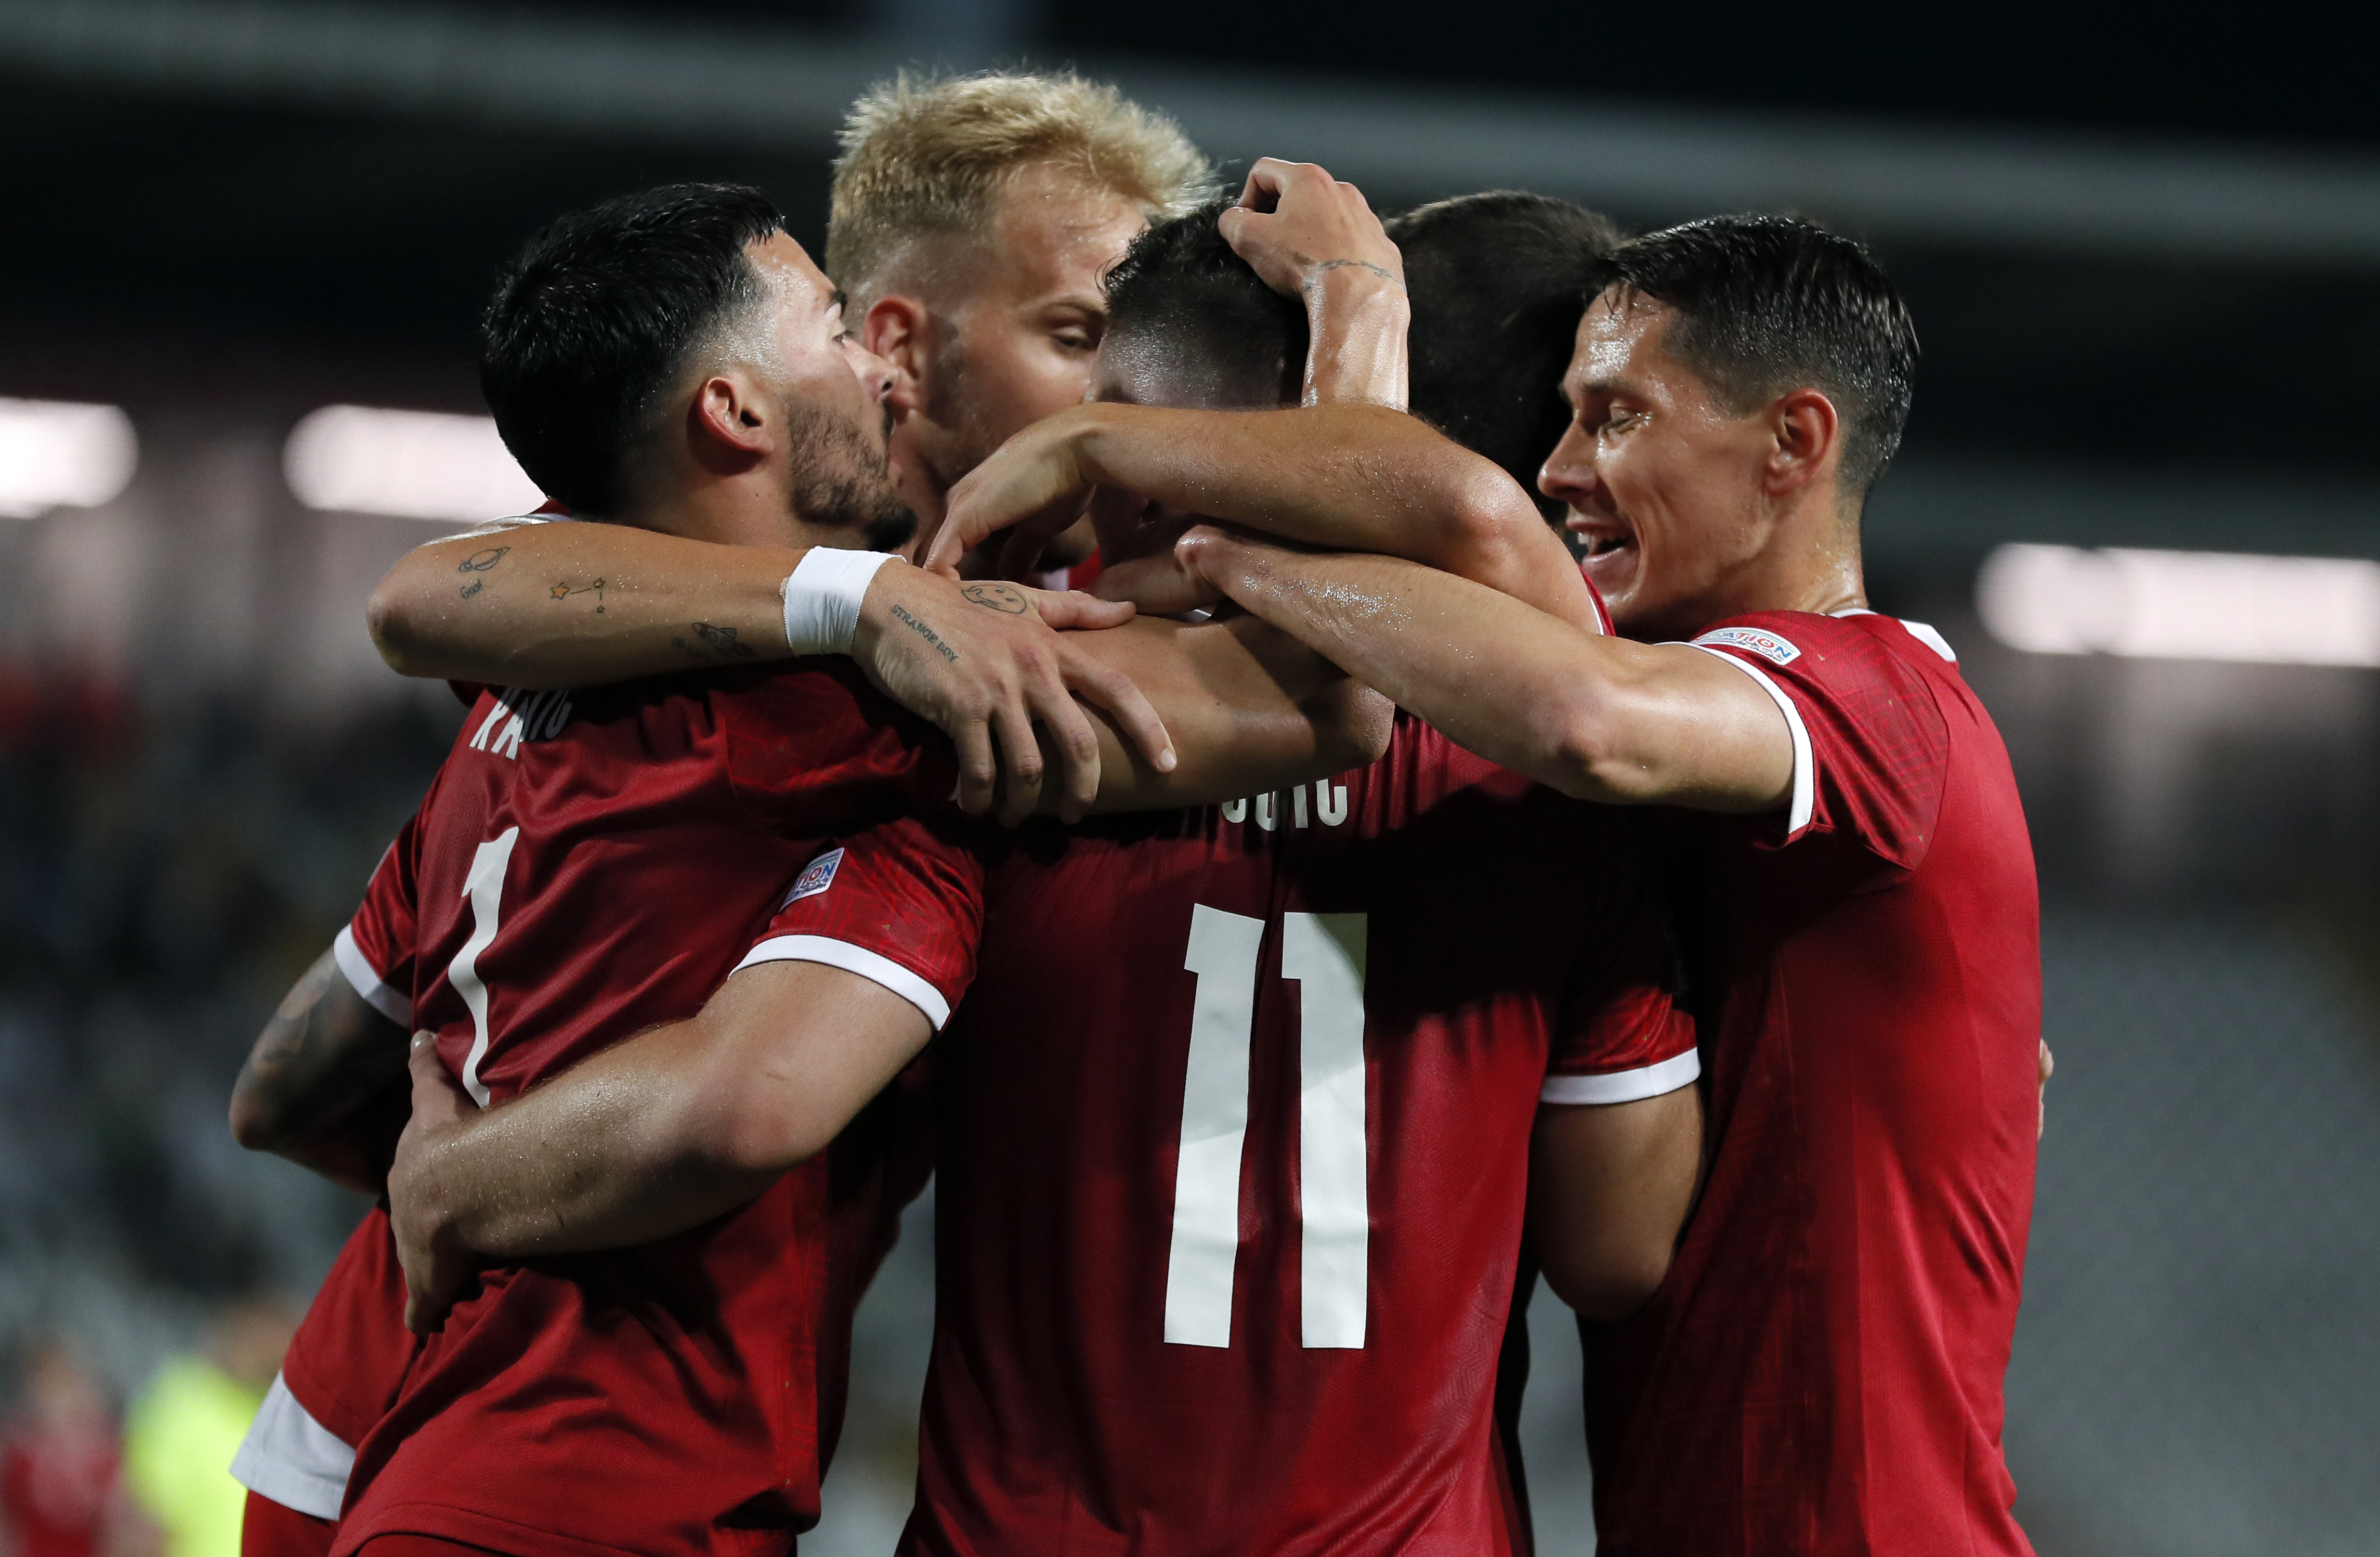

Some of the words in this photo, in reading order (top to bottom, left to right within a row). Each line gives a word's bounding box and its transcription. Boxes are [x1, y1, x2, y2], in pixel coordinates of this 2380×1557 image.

[892, 604, 938, 643] STRANGE
[937, 641, 958, 663] BOY
[1164, 903, 1368, 1350] 11
